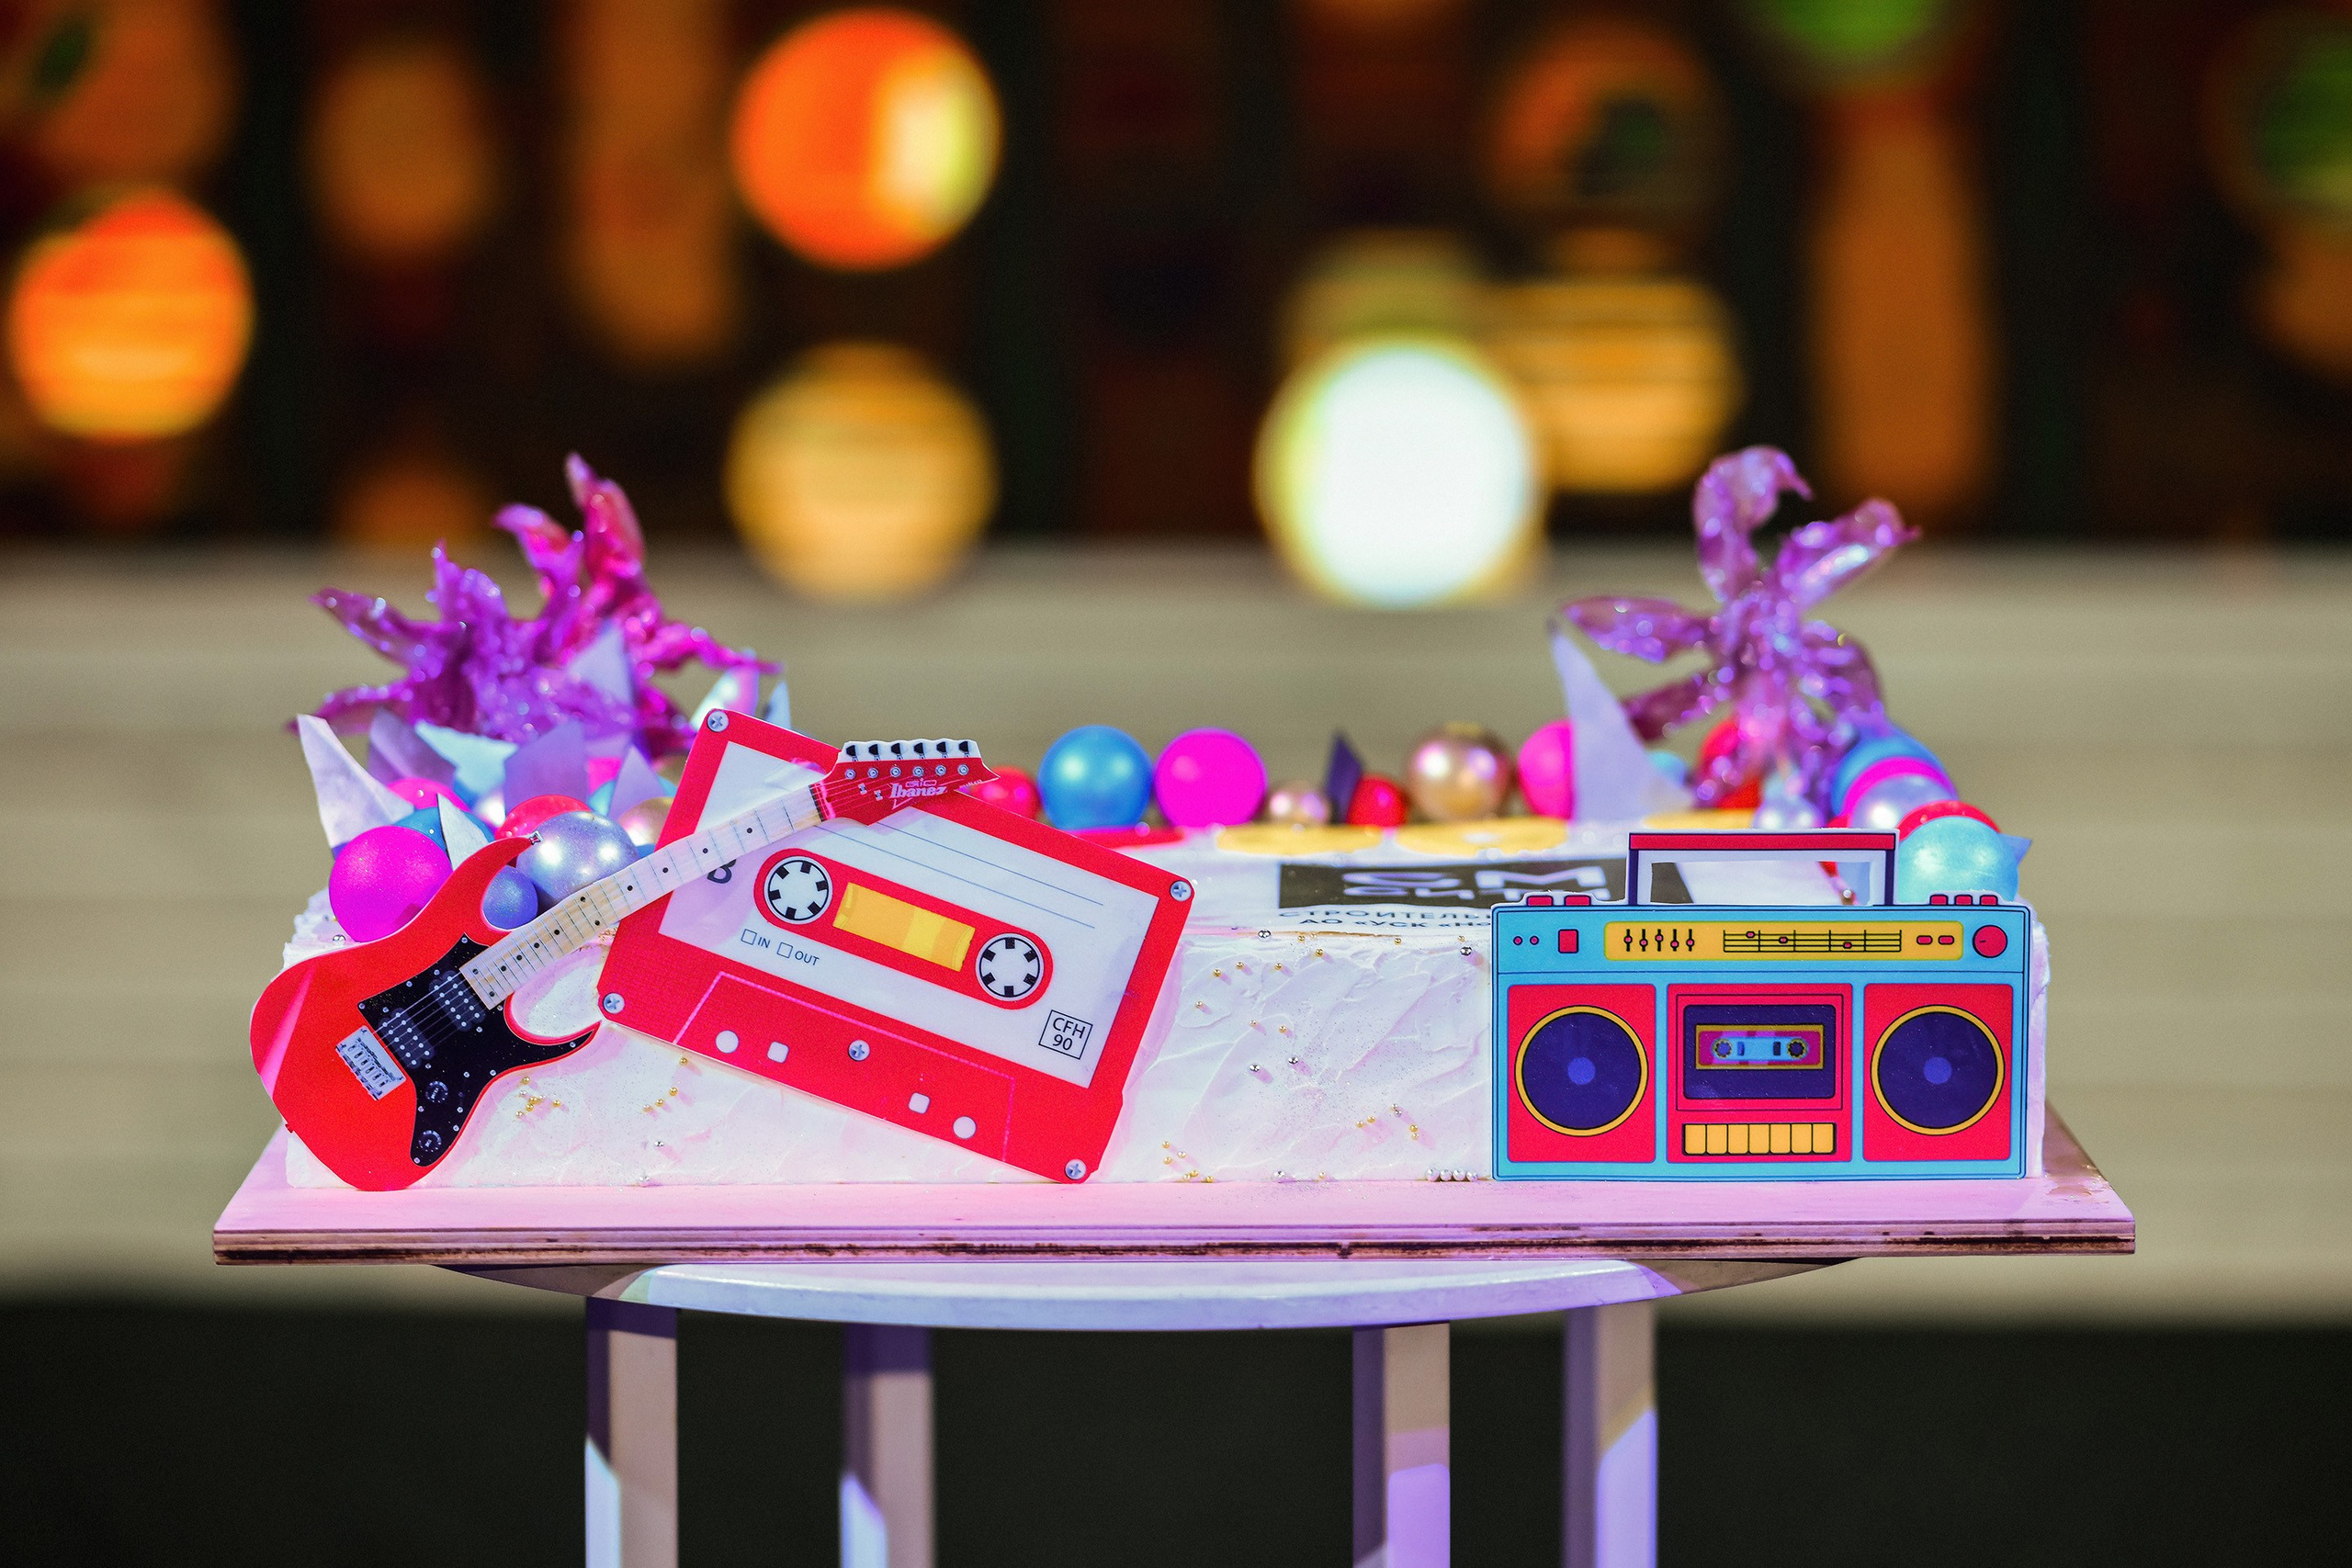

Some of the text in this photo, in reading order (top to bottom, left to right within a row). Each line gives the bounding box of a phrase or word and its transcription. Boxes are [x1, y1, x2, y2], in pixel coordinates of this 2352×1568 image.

[889, 782, 947, 798] Ibanez
[1279, 909, 1491, 919] СТРОИТЕЛЬ
[757, 936, 820, 966] IN OUT
[1052, 1017, 1086, 1039] CFH
[1052, 1033, 1073, 1051] 90
